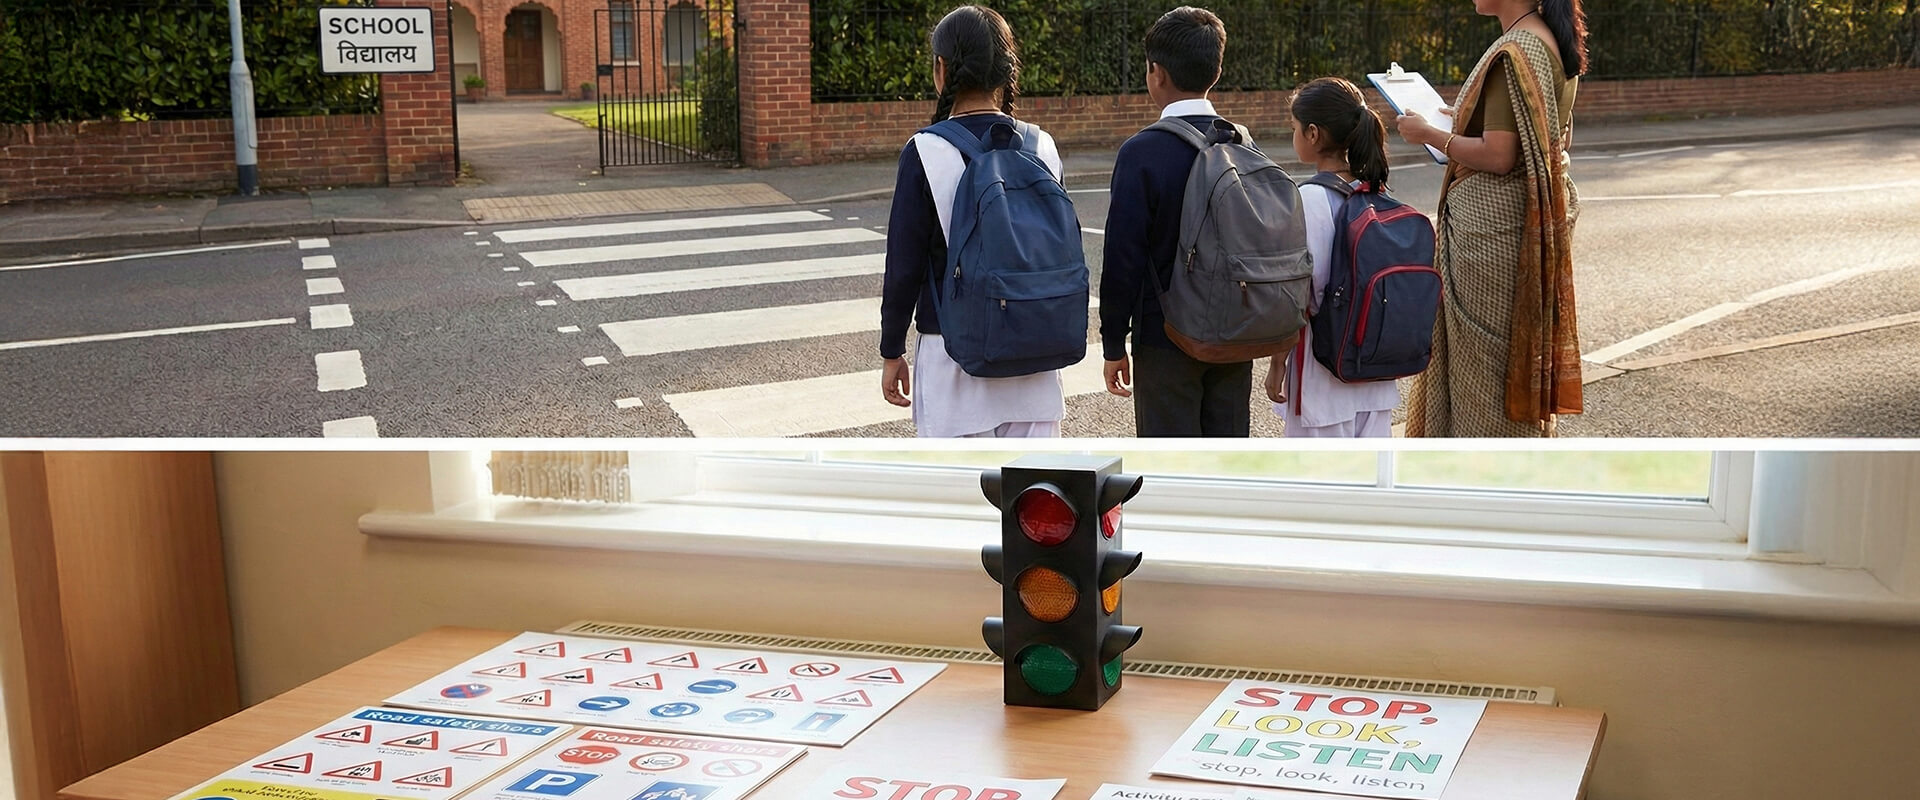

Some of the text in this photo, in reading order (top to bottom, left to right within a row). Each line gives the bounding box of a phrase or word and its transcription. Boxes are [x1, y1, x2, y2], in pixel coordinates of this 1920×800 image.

[329, 17, 424, 34] SCHOOL
[337, 40, 417, 63] विद्यालय
[1234, 687, 1439, 725] STOP,
[365, 711, 419, 722] Road
[420, 718, 483, 730] safety
[1213, 709, 1422, 749] LOOK,
[591, 732, 646, 744] Road
[563, 748, 616, 760] STOP
[1192, 733, 1442, 774] LISTEN
[525, 773, 577, 790] P
[1200, 761, 1262, 777] stop,
[1276, 767, 1338, 784] look,
